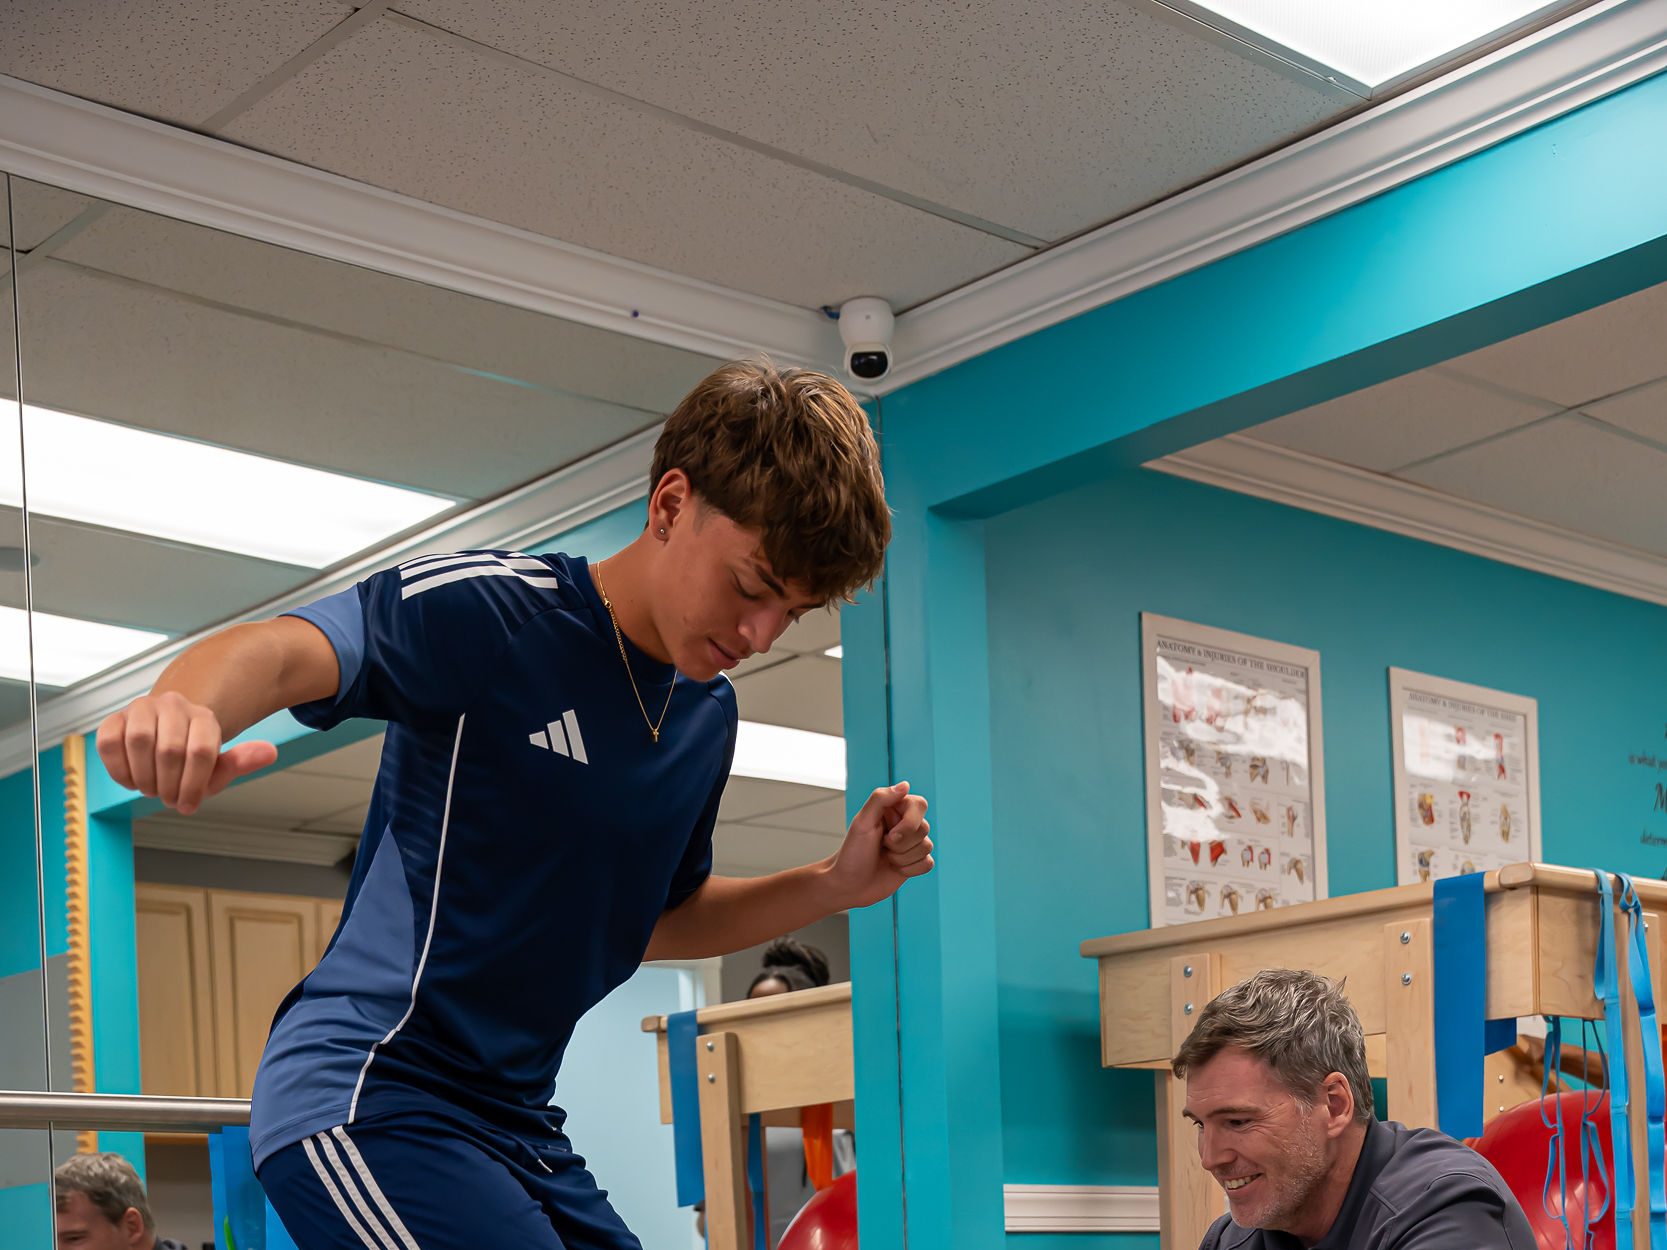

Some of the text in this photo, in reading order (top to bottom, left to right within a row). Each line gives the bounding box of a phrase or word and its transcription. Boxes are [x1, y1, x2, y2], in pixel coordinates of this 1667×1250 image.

[1157, 640, 1197, 655] ANATOMY
[1203, 651, 1236, 664] INJURIES
[1238, 657, 1247, 665] OF
[1249, 659, 1264, 669] THE
[1266, 663, 1305, 678] SHOULDER
